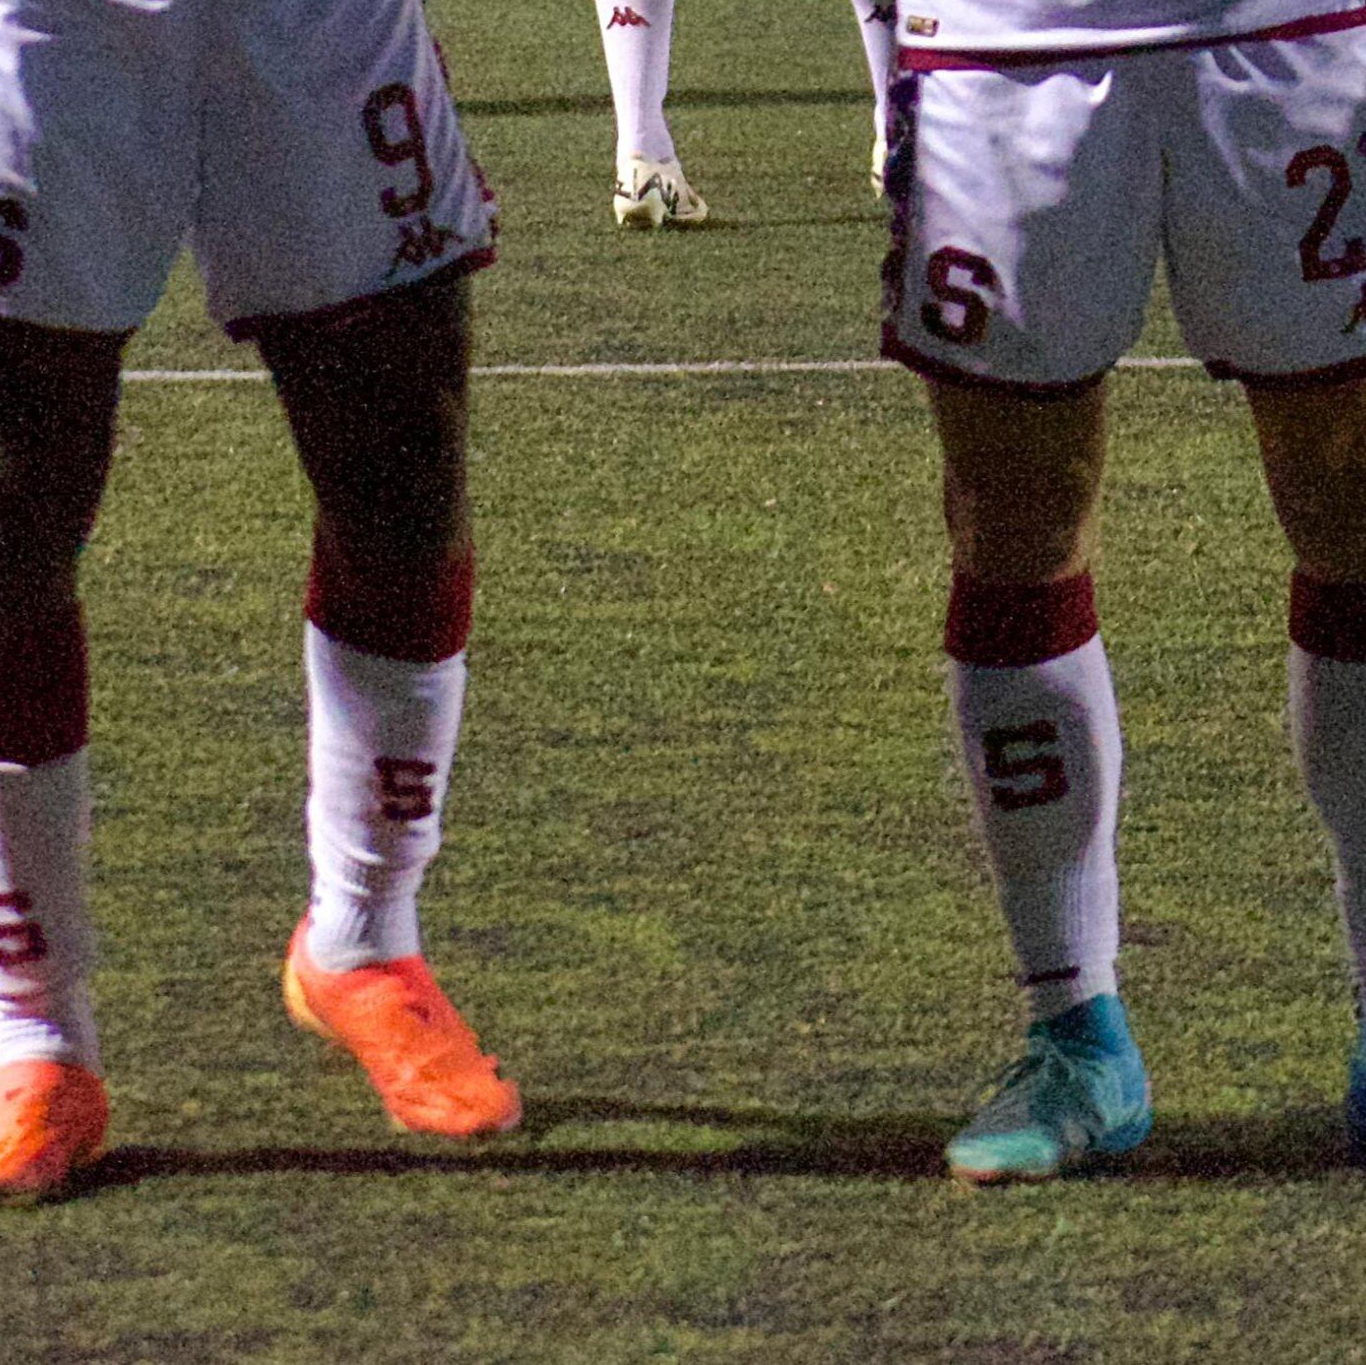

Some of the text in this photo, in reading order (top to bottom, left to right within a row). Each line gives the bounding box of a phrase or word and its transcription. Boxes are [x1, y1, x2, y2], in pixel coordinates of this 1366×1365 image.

[362, 81, 431, 217] 9
[921, 244, 1001, 345] S
[373, 757, 436, 821] S
[982, 720, 1070, 813] S
